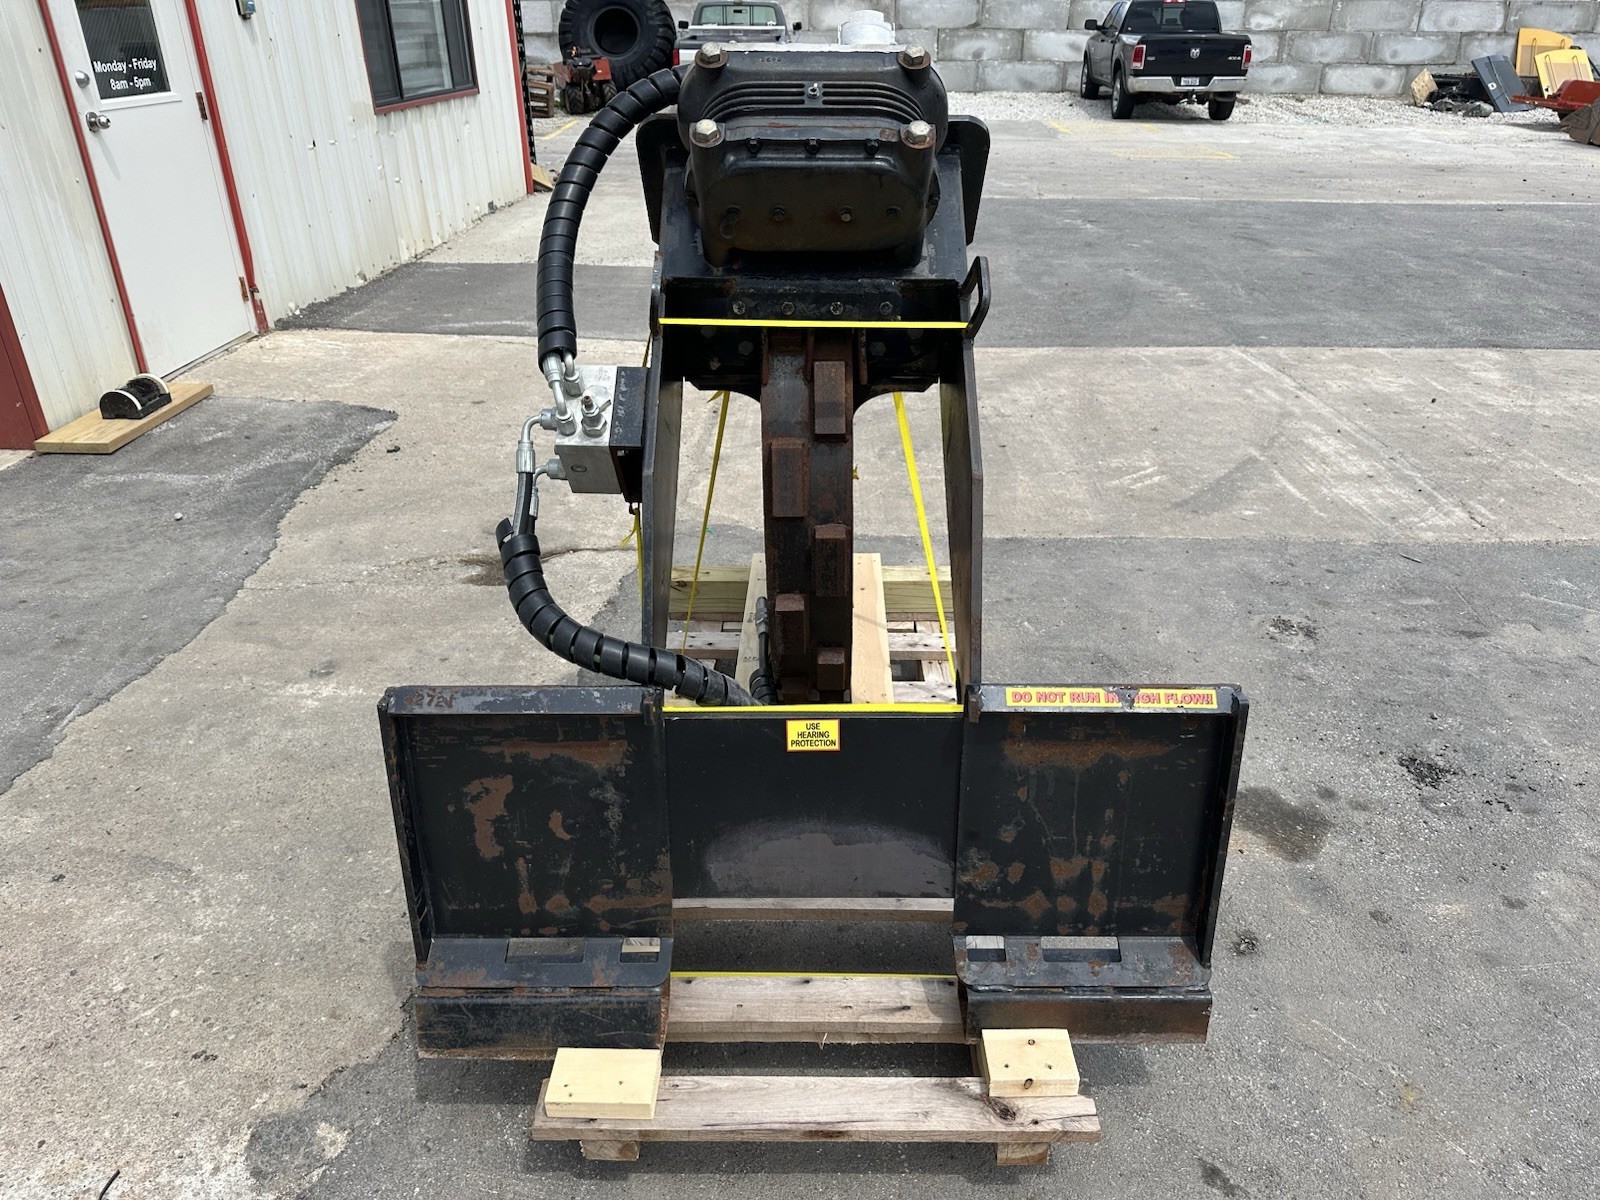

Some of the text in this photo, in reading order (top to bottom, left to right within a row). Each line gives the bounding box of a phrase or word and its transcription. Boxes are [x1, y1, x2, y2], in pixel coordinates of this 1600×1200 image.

[93, 60, 127, 73] Monday
[132, 57, 157, 71] Friday
[110, 78, 129, 90] 8am
[133, 76, 152, 90] 5pm
[1012, 691, 1032, 703] DO
[1036, 691, 1066, 703] NOT
[1070, 691, 1100, 703] RUN
[1104, 692, 1120, 703] IN
[1164, 692, 1214, 705] FLOW!!
[806, 722, 821, 731] USE
[797, 730, 830, 739] HEARING
[790, 739, 836, 747] PROTECTION
